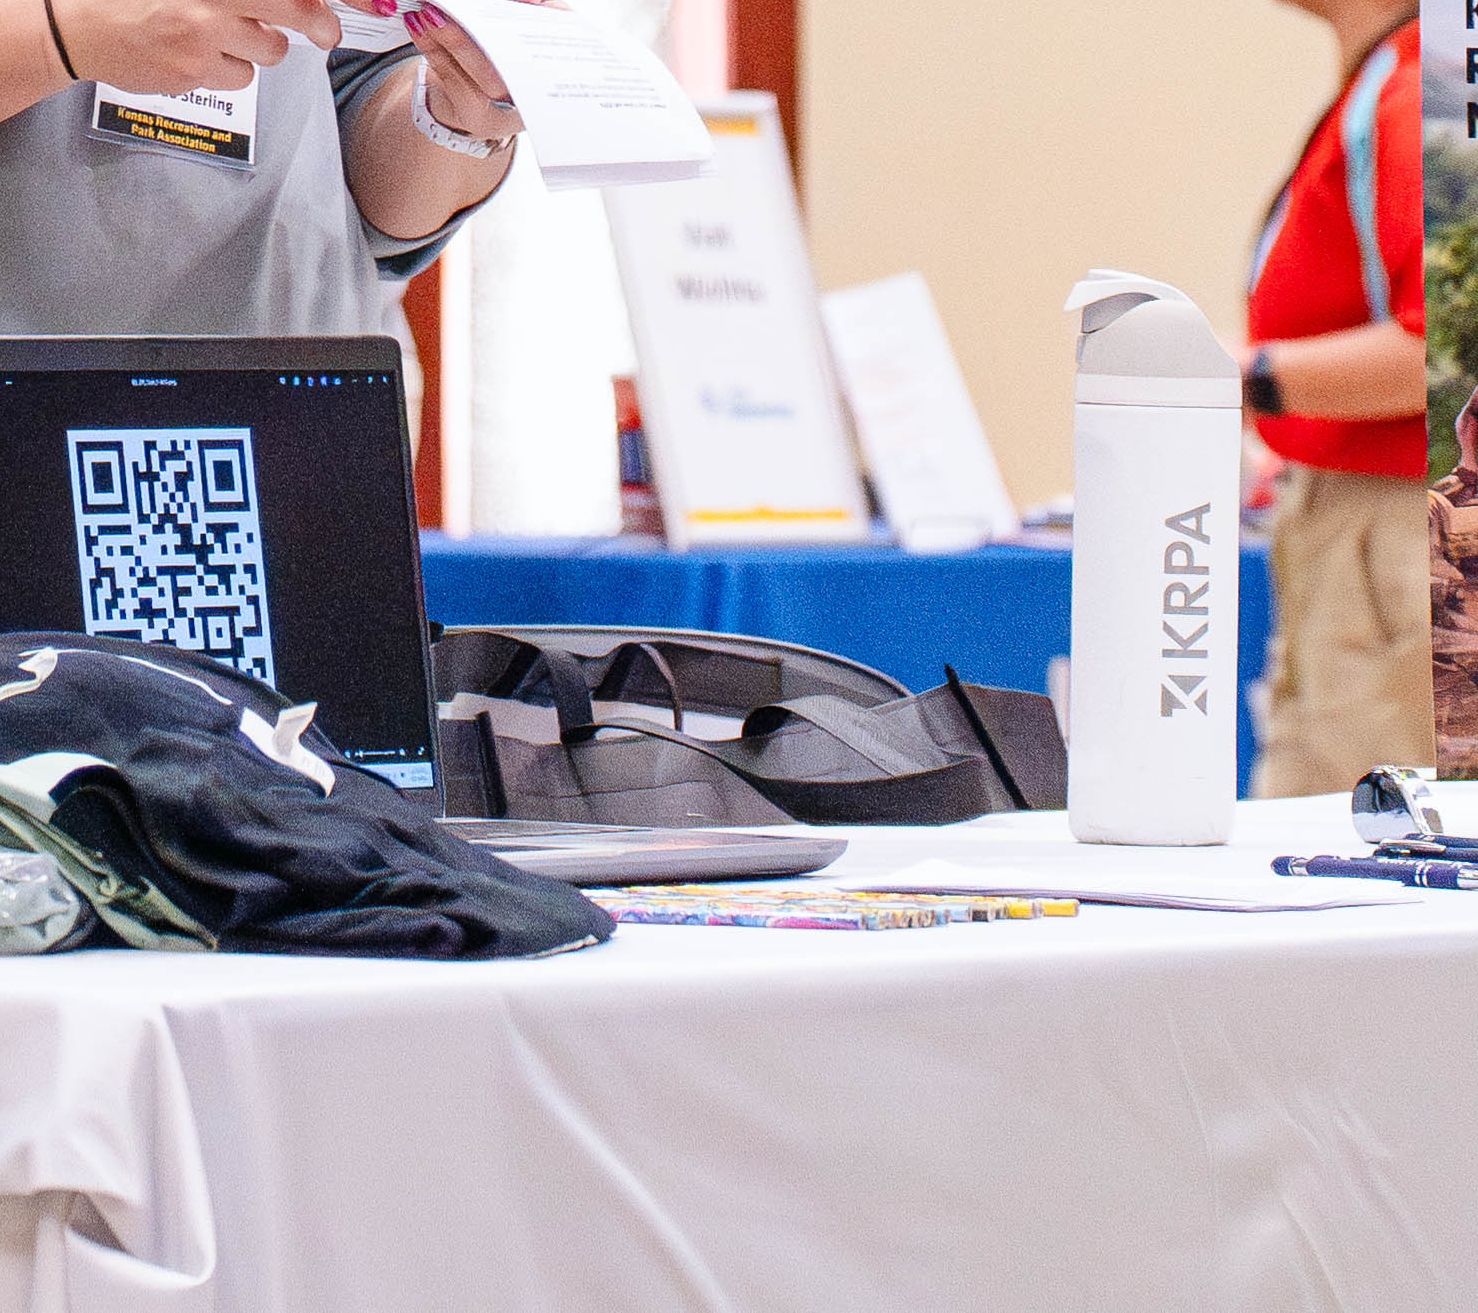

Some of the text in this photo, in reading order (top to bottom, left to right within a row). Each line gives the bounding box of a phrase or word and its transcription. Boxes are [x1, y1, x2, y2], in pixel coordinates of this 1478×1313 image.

[117, 107, 232, 143] Kansas Recreation and
[131, 123, 216, 153] Park Association
[1161, 502, 1211, 659] KRPA
